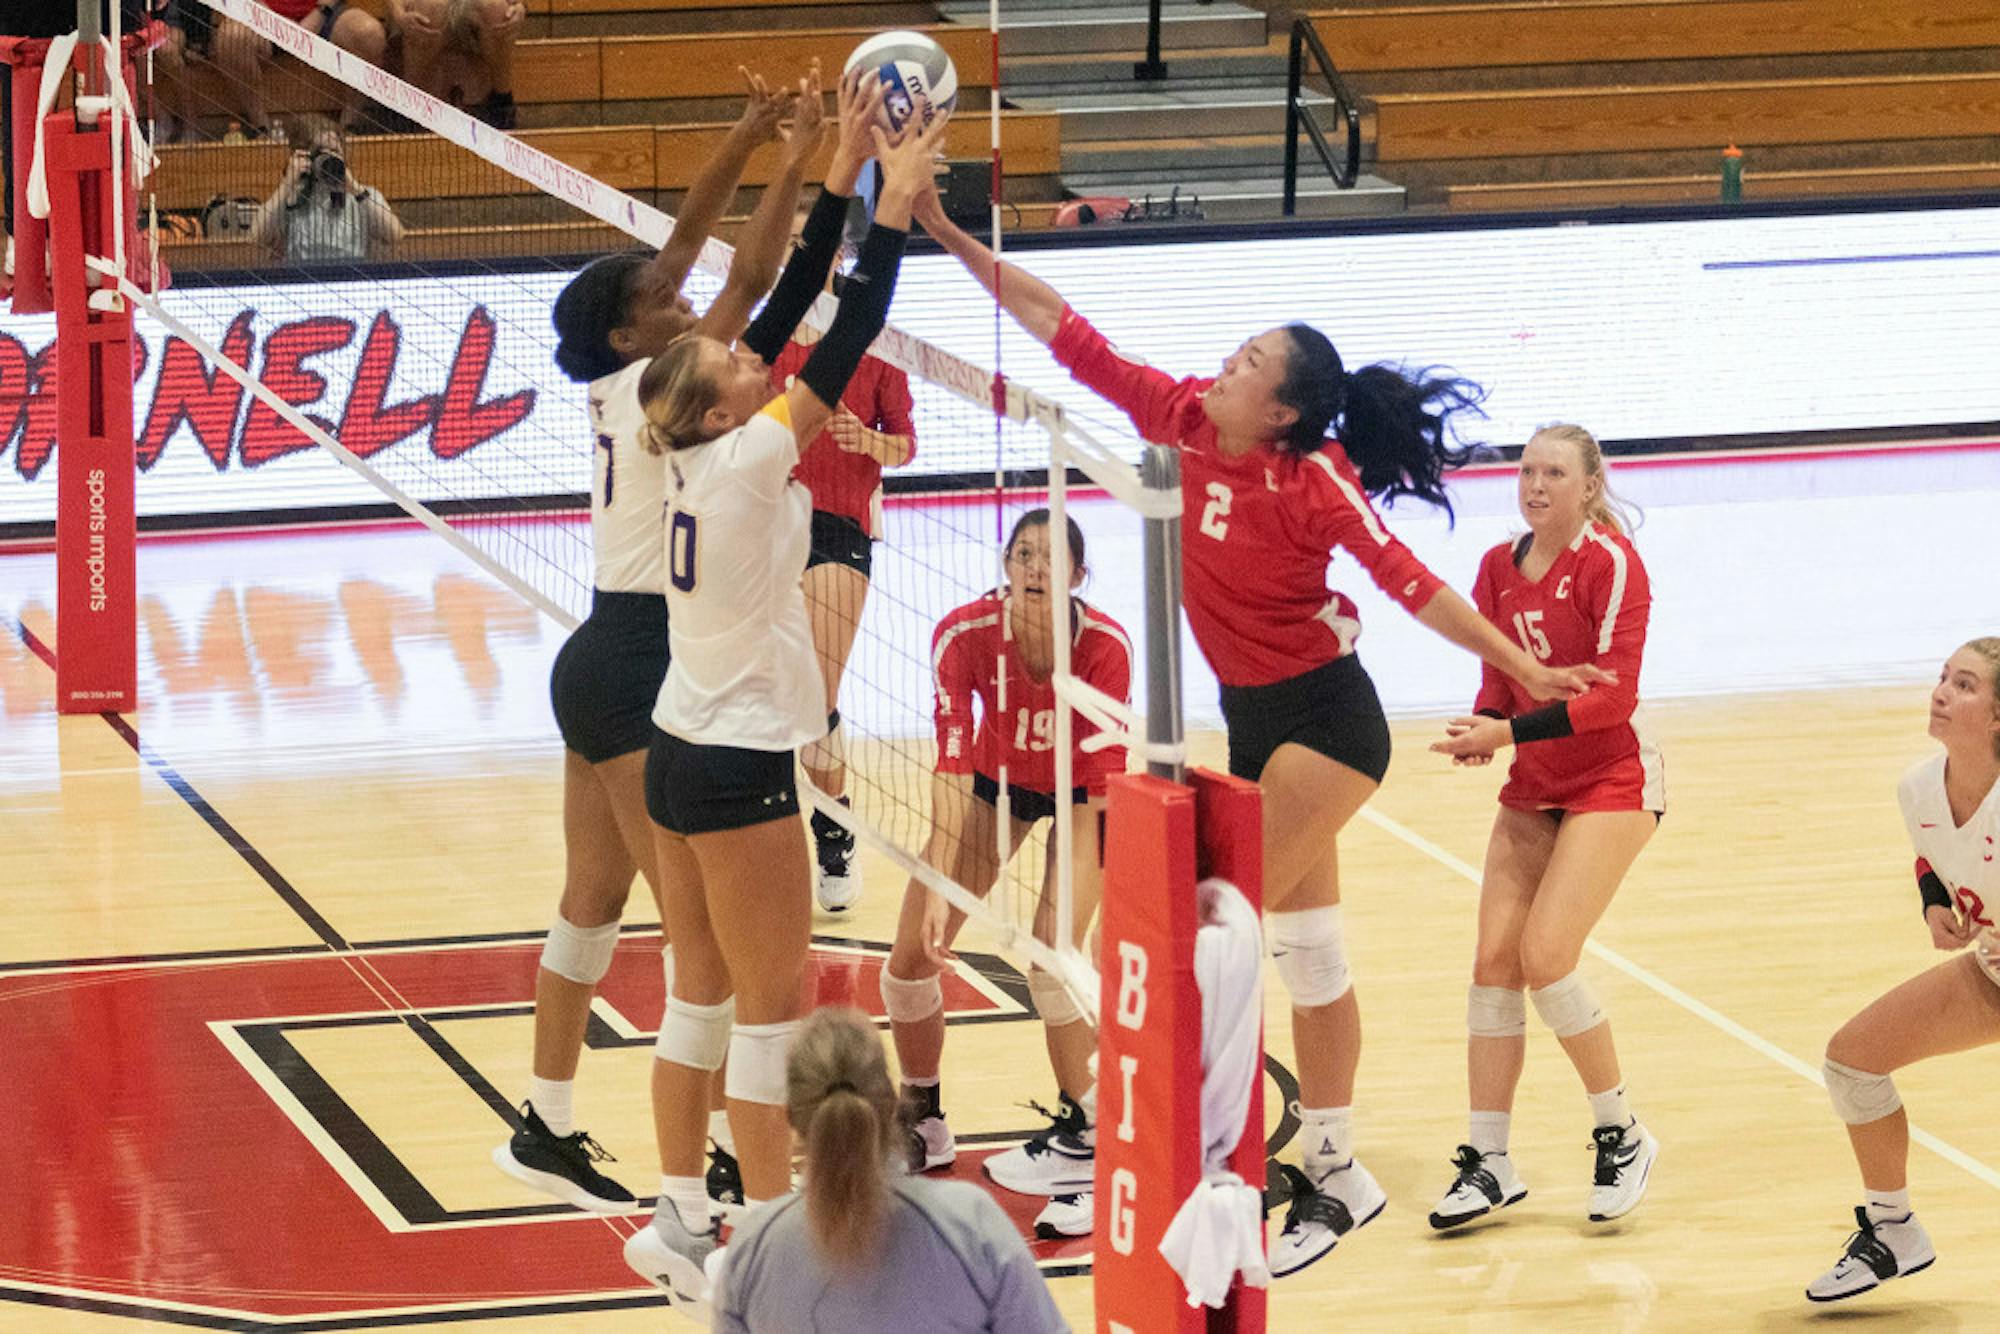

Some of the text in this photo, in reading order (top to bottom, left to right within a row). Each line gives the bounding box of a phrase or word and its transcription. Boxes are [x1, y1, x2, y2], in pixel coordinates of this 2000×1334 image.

[1200, 481, 1232, 541] 2
[86, 469, 107, 611] sports imports
[1555, 575, 1571, 599] C
[1512, 610, 1552, 660] 15
[1013, 707, 1056, 752] 19
[1109, 939, 1149, 1258] BIG
